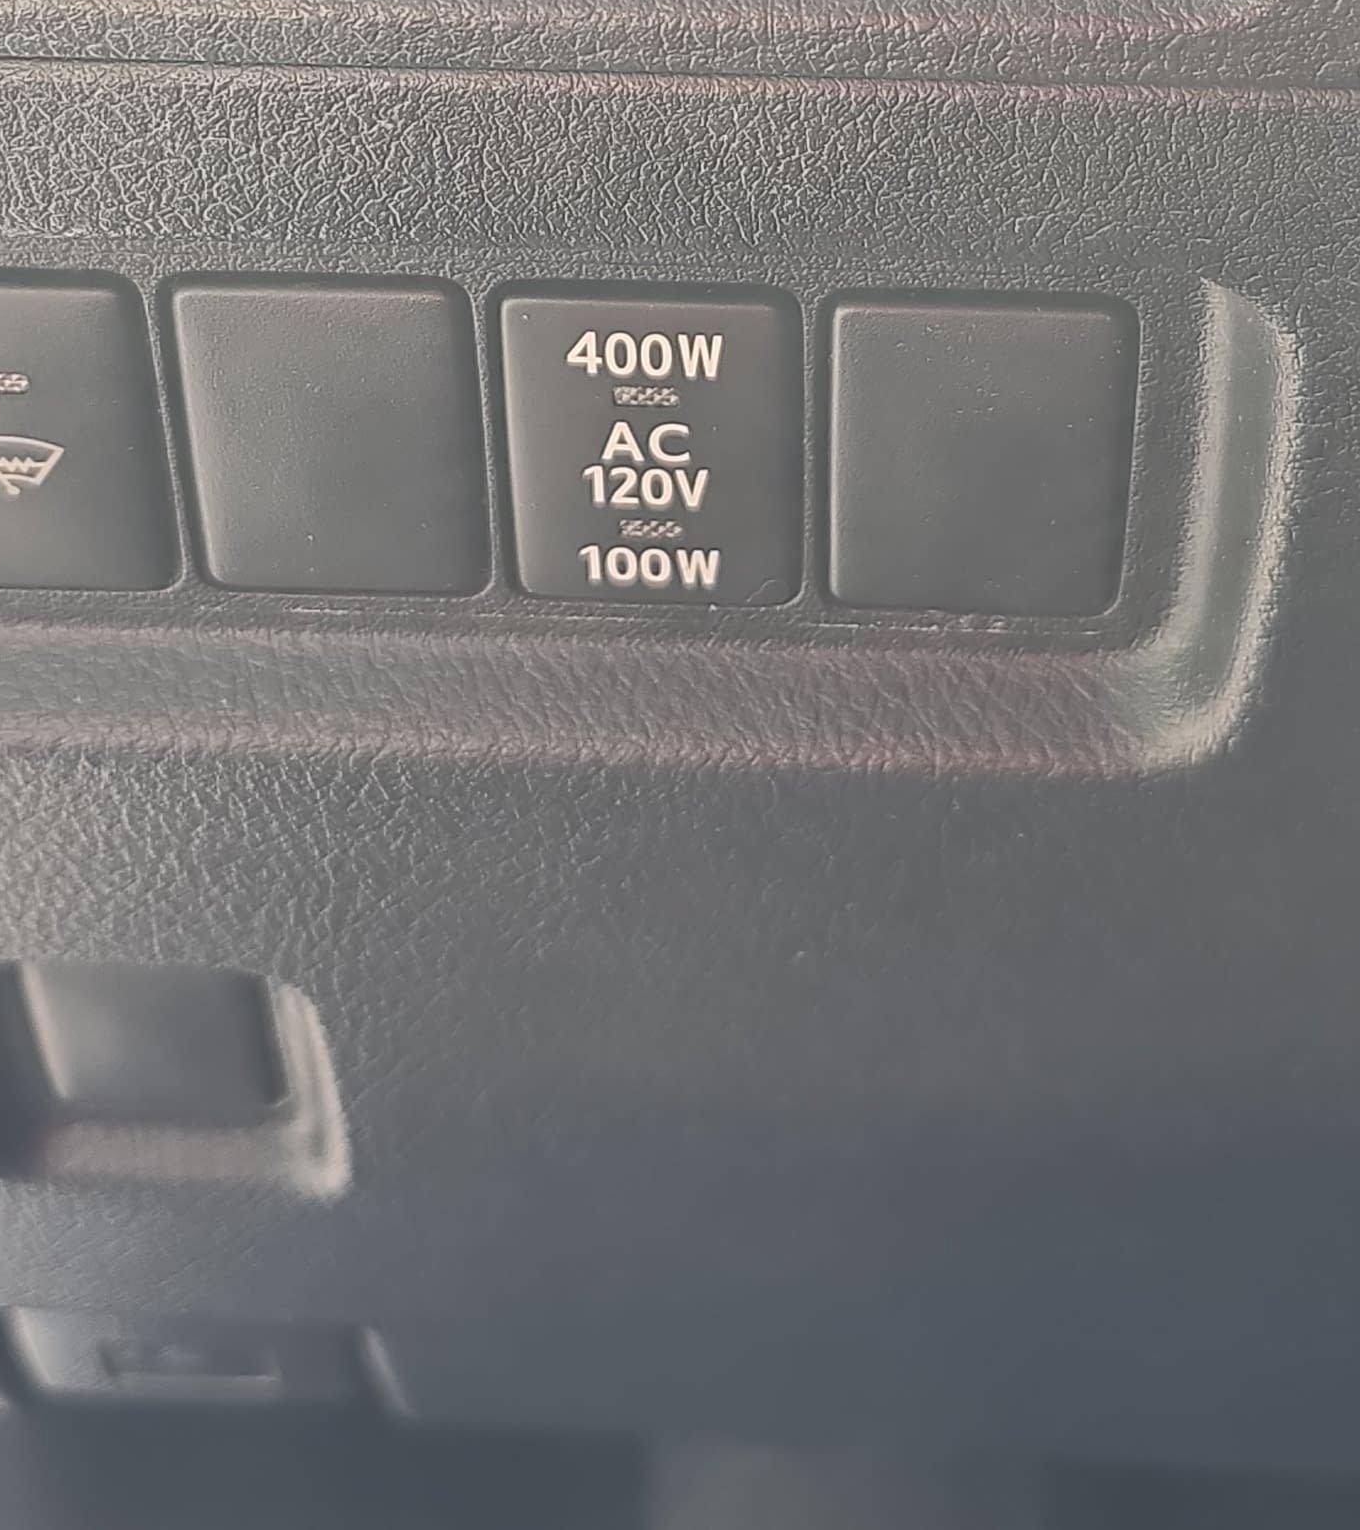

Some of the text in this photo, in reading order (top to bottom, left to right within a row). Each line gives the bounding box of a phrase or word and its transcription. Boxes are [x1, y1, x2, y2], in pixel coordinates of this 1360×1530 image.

[566, 330, 724, 381] 400W
[601, 420, 692, 464] AC
[582, 465, 710, 512] 120V
[578, 544, 721, 590] 100W
